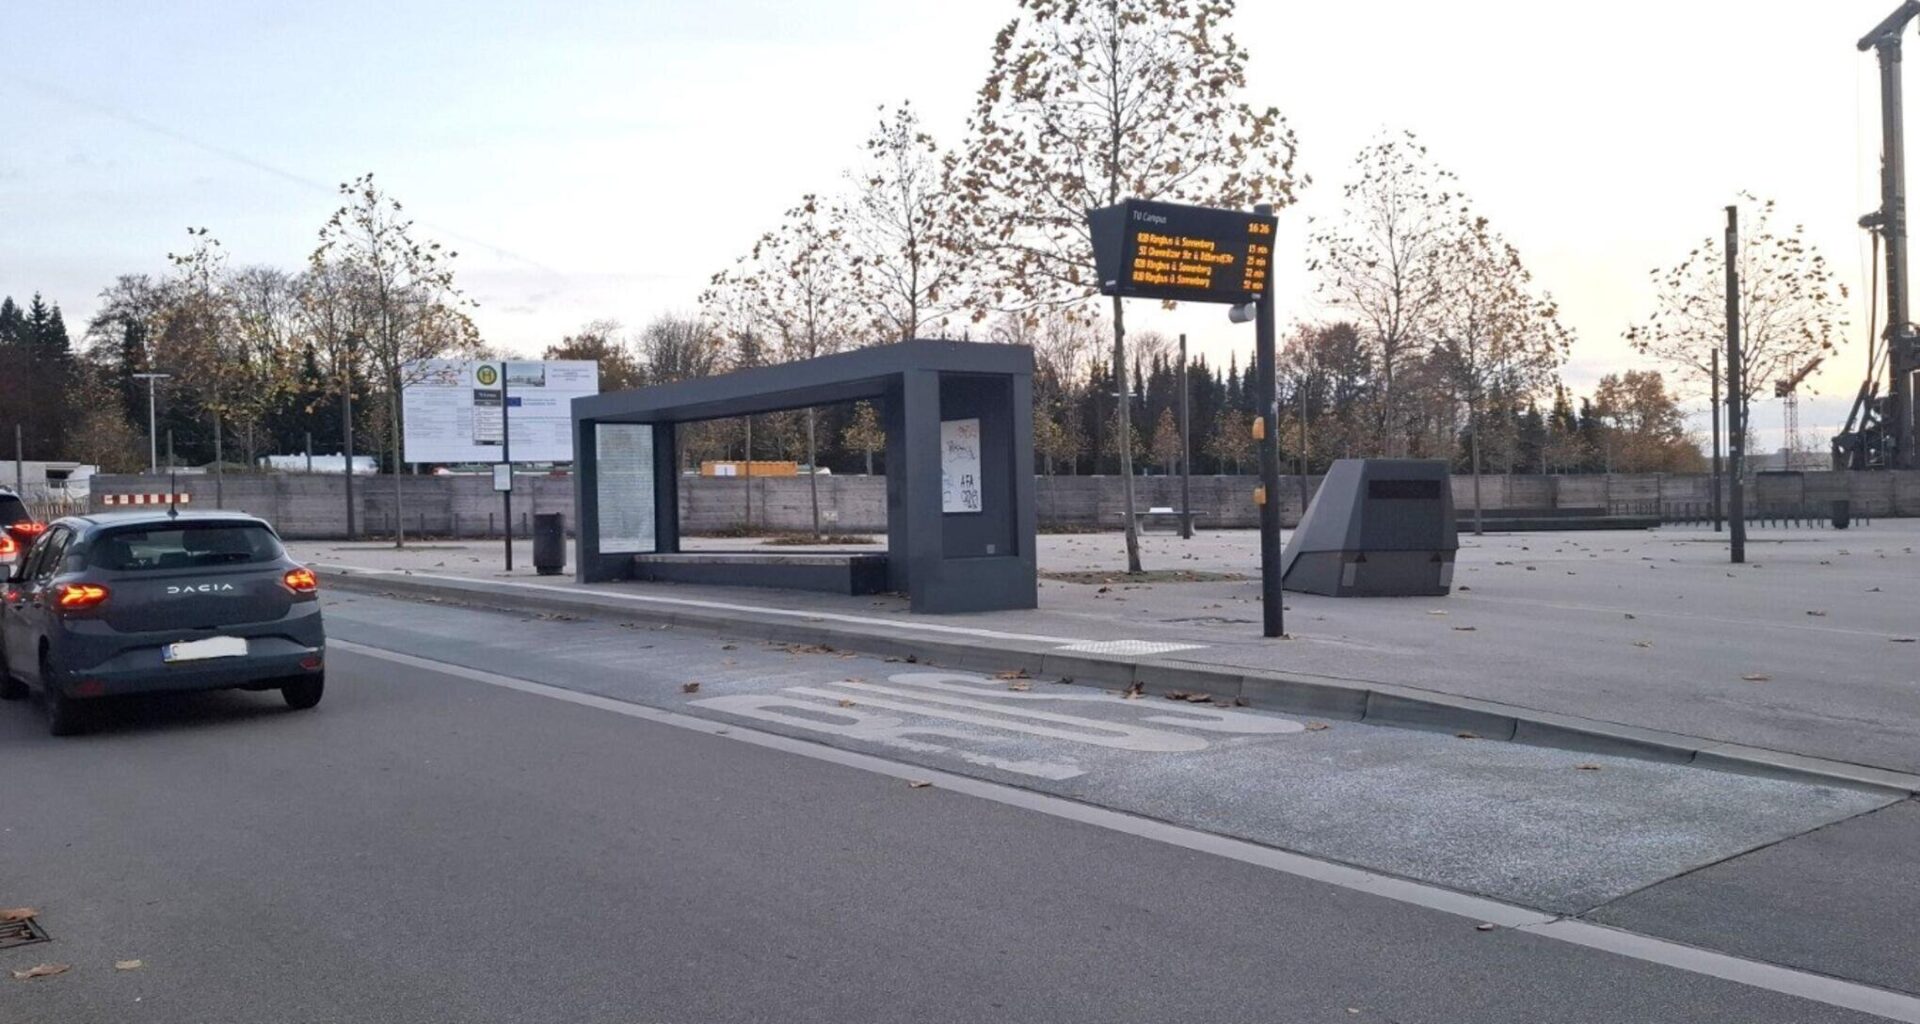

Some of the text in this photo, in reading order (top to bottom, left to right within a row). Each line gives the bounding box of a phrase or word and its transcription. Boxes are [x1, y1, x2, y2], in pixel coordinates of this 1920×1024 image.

[1143, 212, 1167, 224] Campus
[1149, 234, 1174, 247] Ringbus
[1182, 236, 1215, 250] Sonnenberg
[1257, 246, 1268, 254] min
[1147, 259, 1170, 272] Ringbus
[1178, 262, 1212, 275] Sonnenberg
[1255, 257, 1266, 266] min
[1253, 268, 1265, 278] min
[1145, 271, 1169, 284] Ringbus
[1177, 274, 1210, 287] Sonnenberg
[1252, 281, 1263, 290] min
[167, 583, 234, 594] DACIA
[686, 672, 1306, 782] BUS
